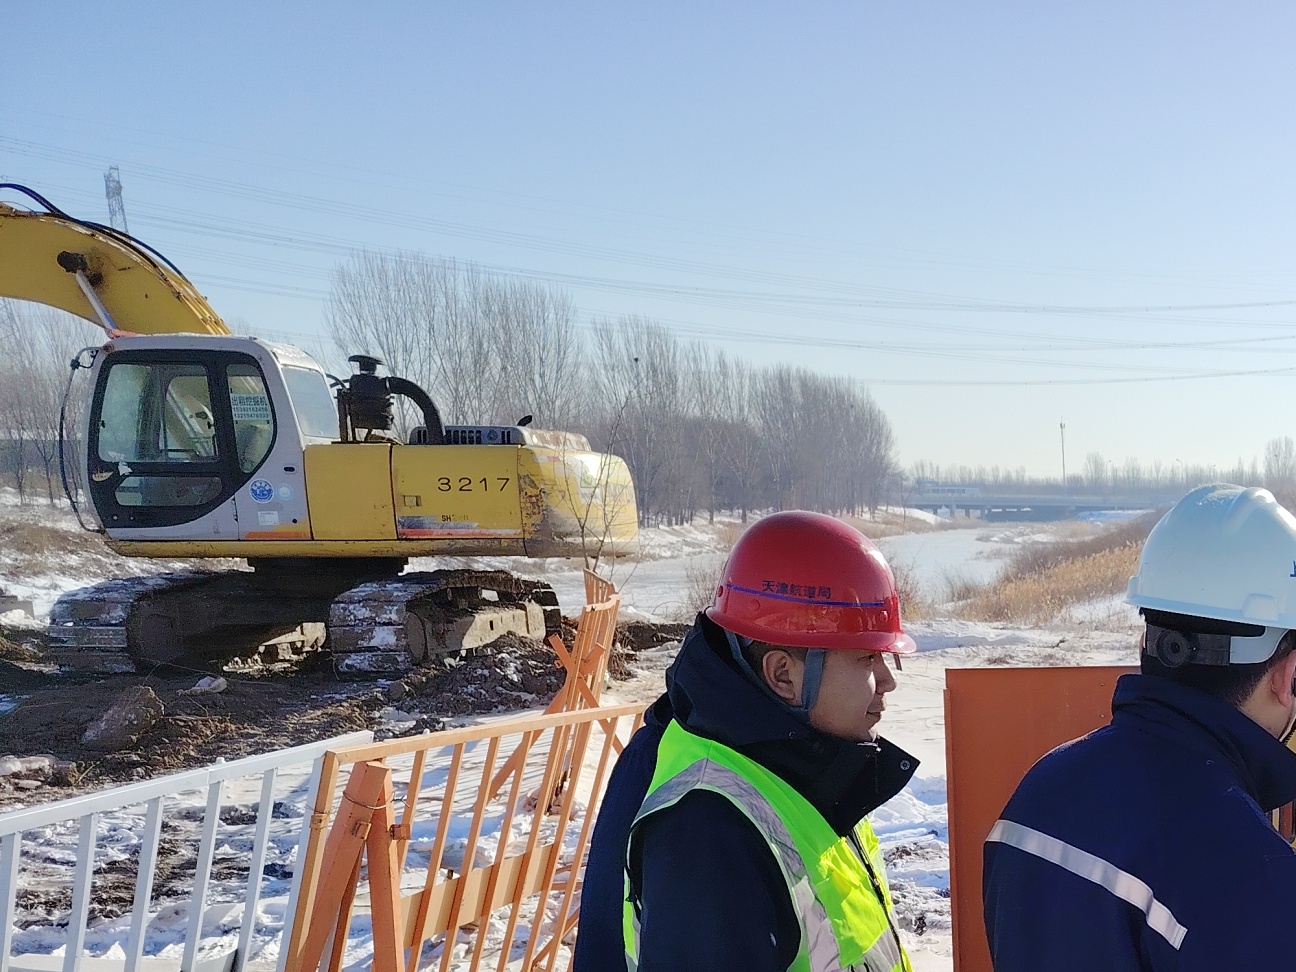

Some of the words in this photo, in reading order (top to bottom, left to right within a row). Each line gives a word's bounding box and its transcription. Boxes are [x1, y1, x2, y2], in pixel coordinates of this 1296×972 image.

[437, 477, 510, 492] 3217
[762, 580, 831, 599] 天津航道局
